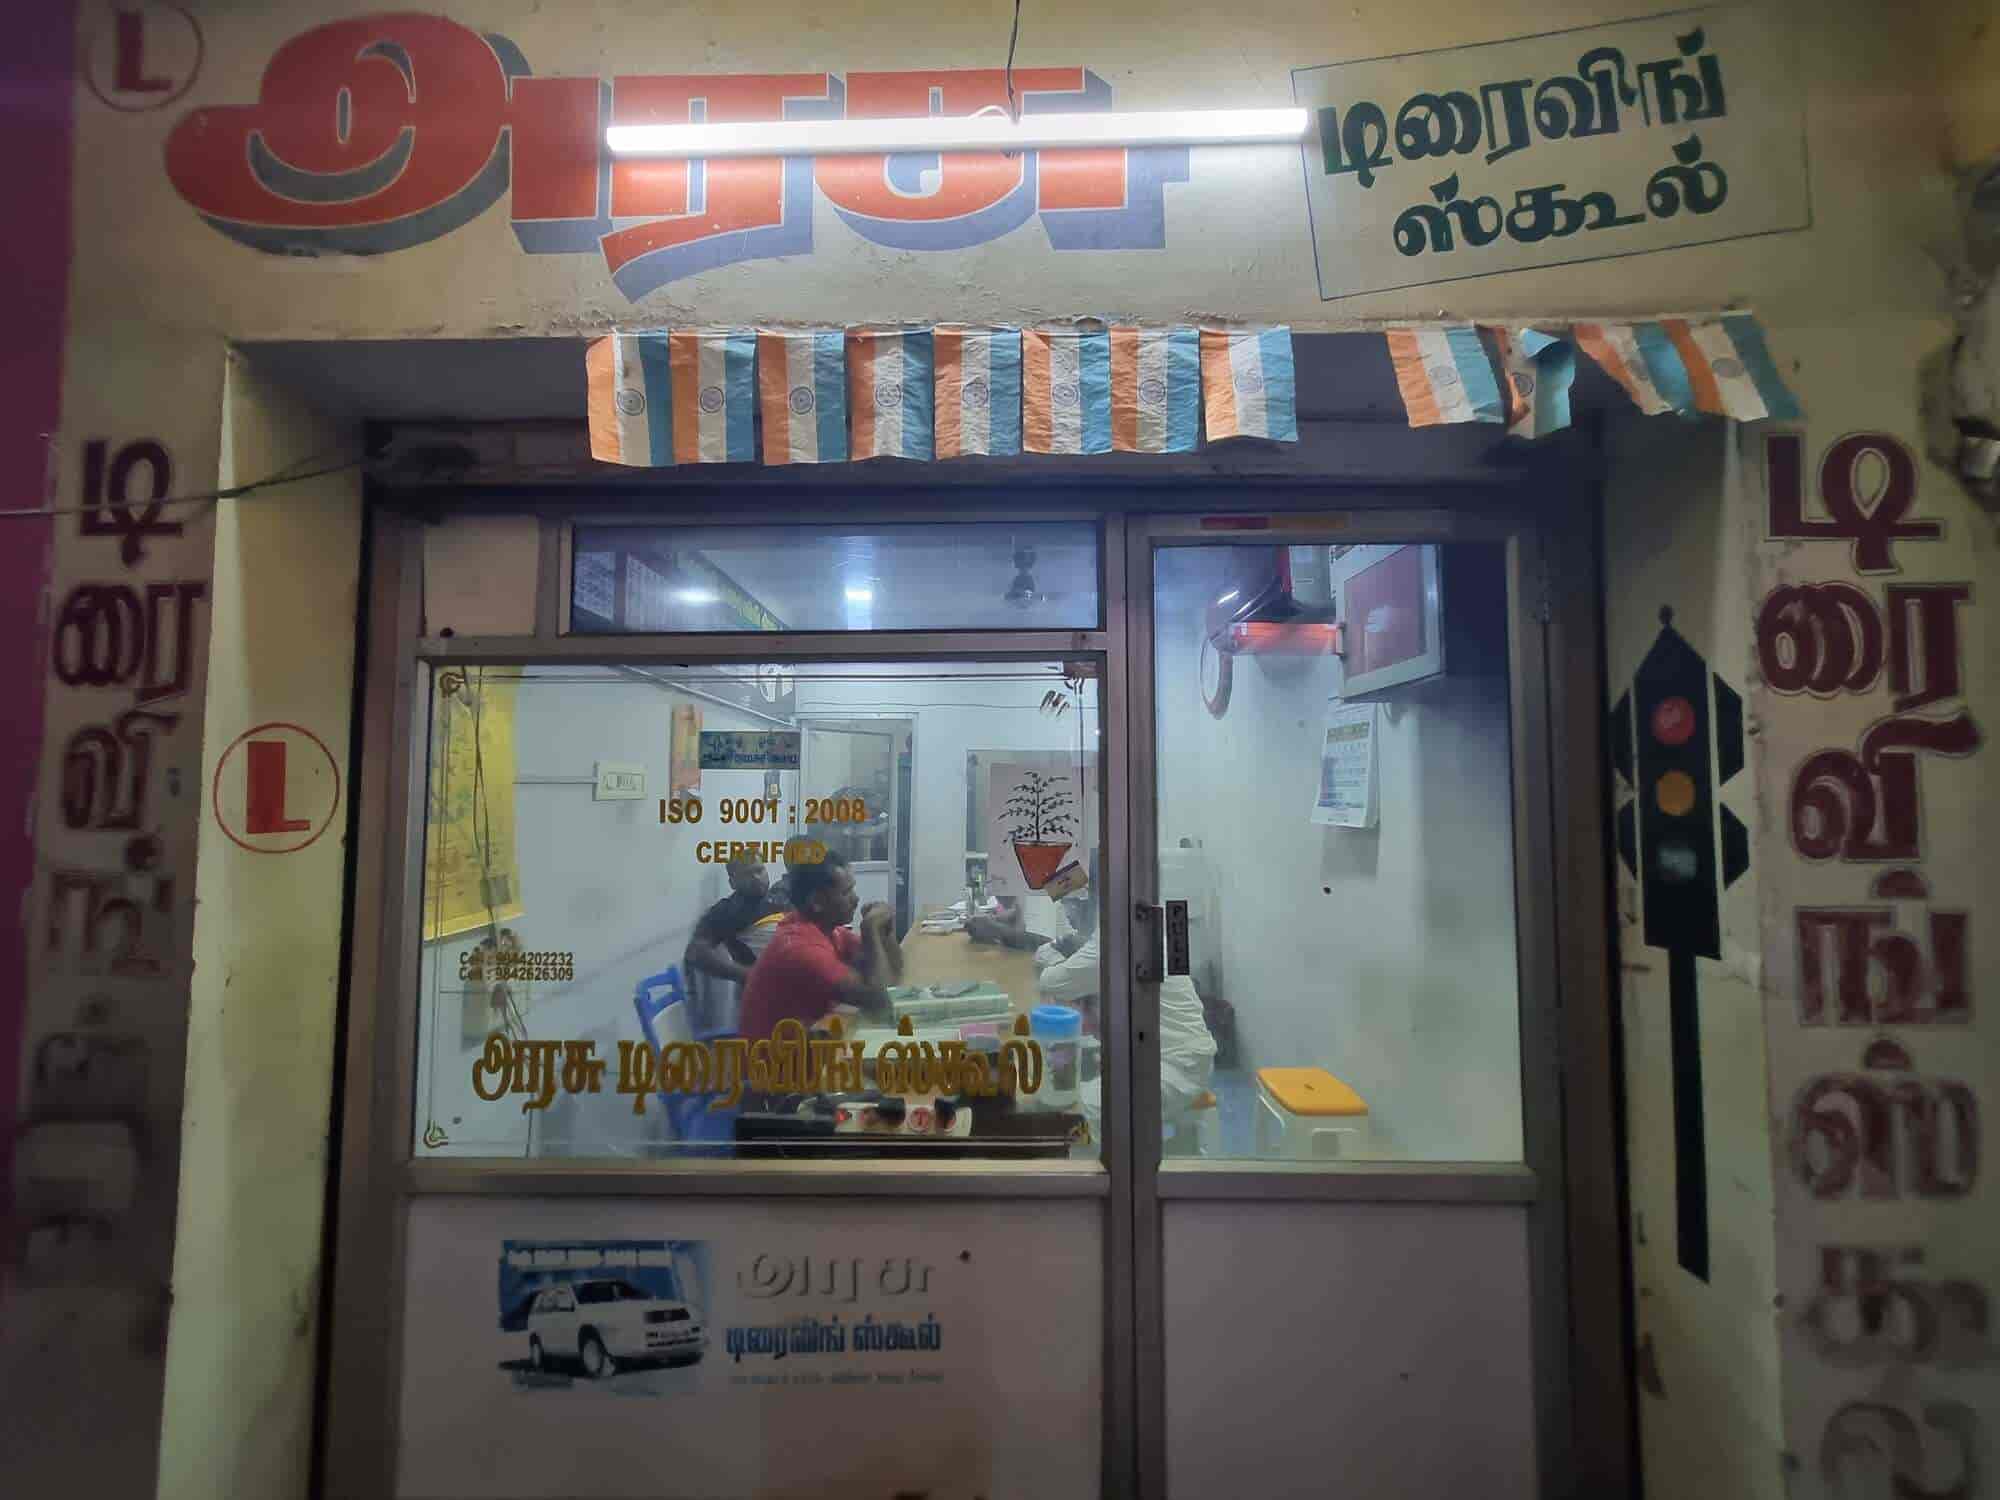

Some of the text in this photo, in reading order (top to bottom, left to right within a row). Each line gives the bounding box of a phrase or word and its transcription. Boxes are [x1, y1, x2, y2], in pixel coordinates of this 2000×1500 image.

[164, 13, 1175, 300] அரசு
[1318, 27, 1728, 189] டிரைவிங்
[1393, 134, 1729, 258] ஸ்கூல்
[245, 740, 311, 835] L
[659, 799, 703, 824] ISO
[719, 799, 779, 824] 9001
[804, 799, 866, 824] 2008
[471, 1029, 606, 1115] அரசு
[615, 1017, 866, 1115] டிரைவிங்
[735, 1252, 937, 1303] அரசு
